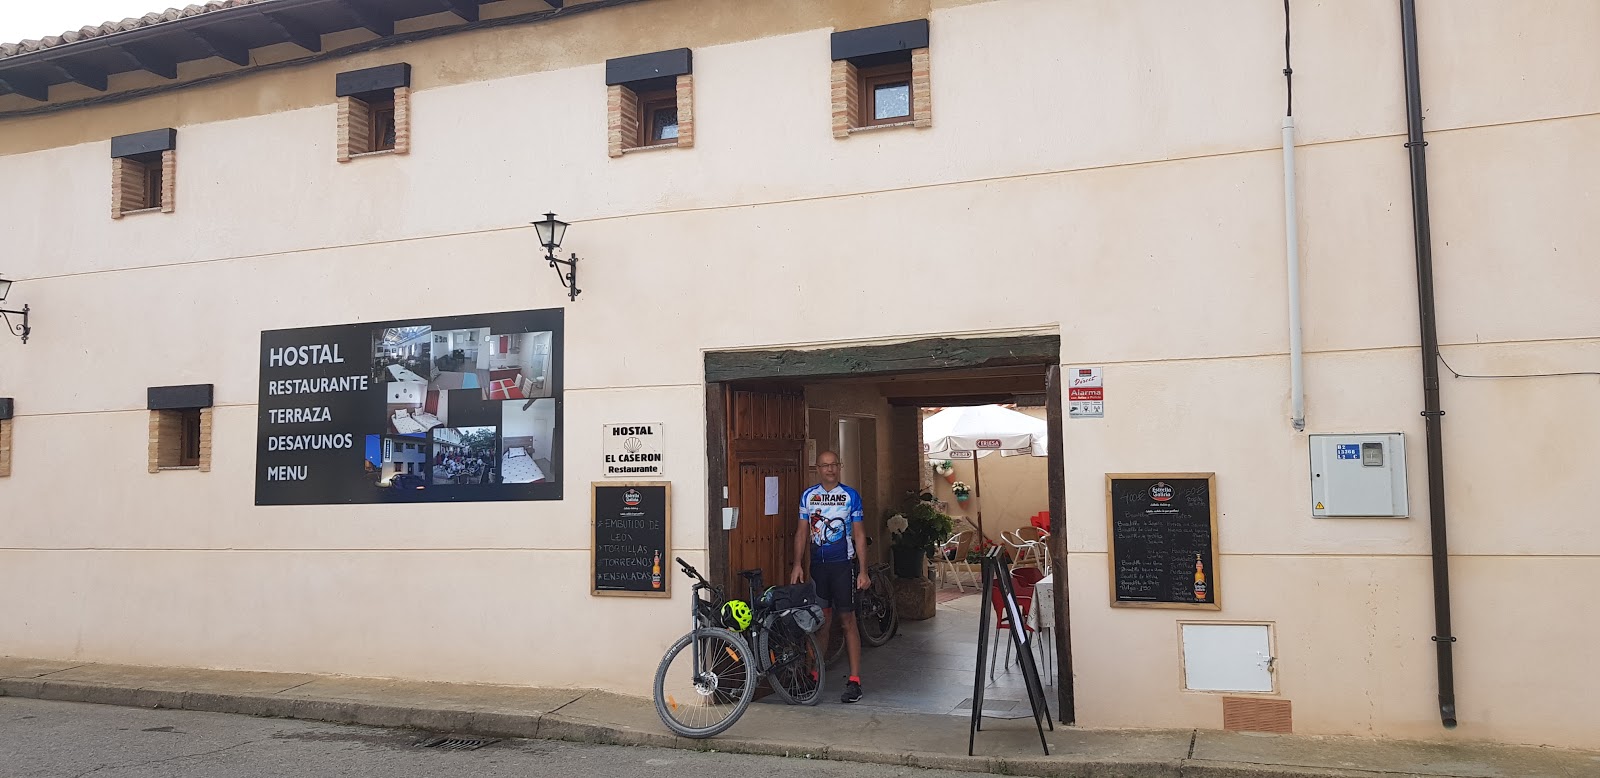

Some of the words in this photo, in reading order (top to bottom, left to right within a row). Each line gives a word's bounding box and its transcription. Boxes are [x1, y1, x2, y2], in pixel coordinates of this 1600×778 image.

[269, 343, 345, 367] HOSTAL
[269, 375, 368, 396] RESTAURANTE
[269, 406, 332, 424] TERRAZA
[612, 426, 653, 436] HOSTAL
[268, 433, 353, 451] DESAYUNOS
[605, 454, 616, 463] EL
[618, 453, 662, 463] CASERON
[267, 465, 308, 481] MENU
[608, 465, 658, 474] Restaurante
[605, 518, 645, 530] EMBUTIDO
[649, 520, 659, 530] DE
[604, 544, 648, 556] TORTILLAS
[603, 571, 652, 581] ENSALADAS
